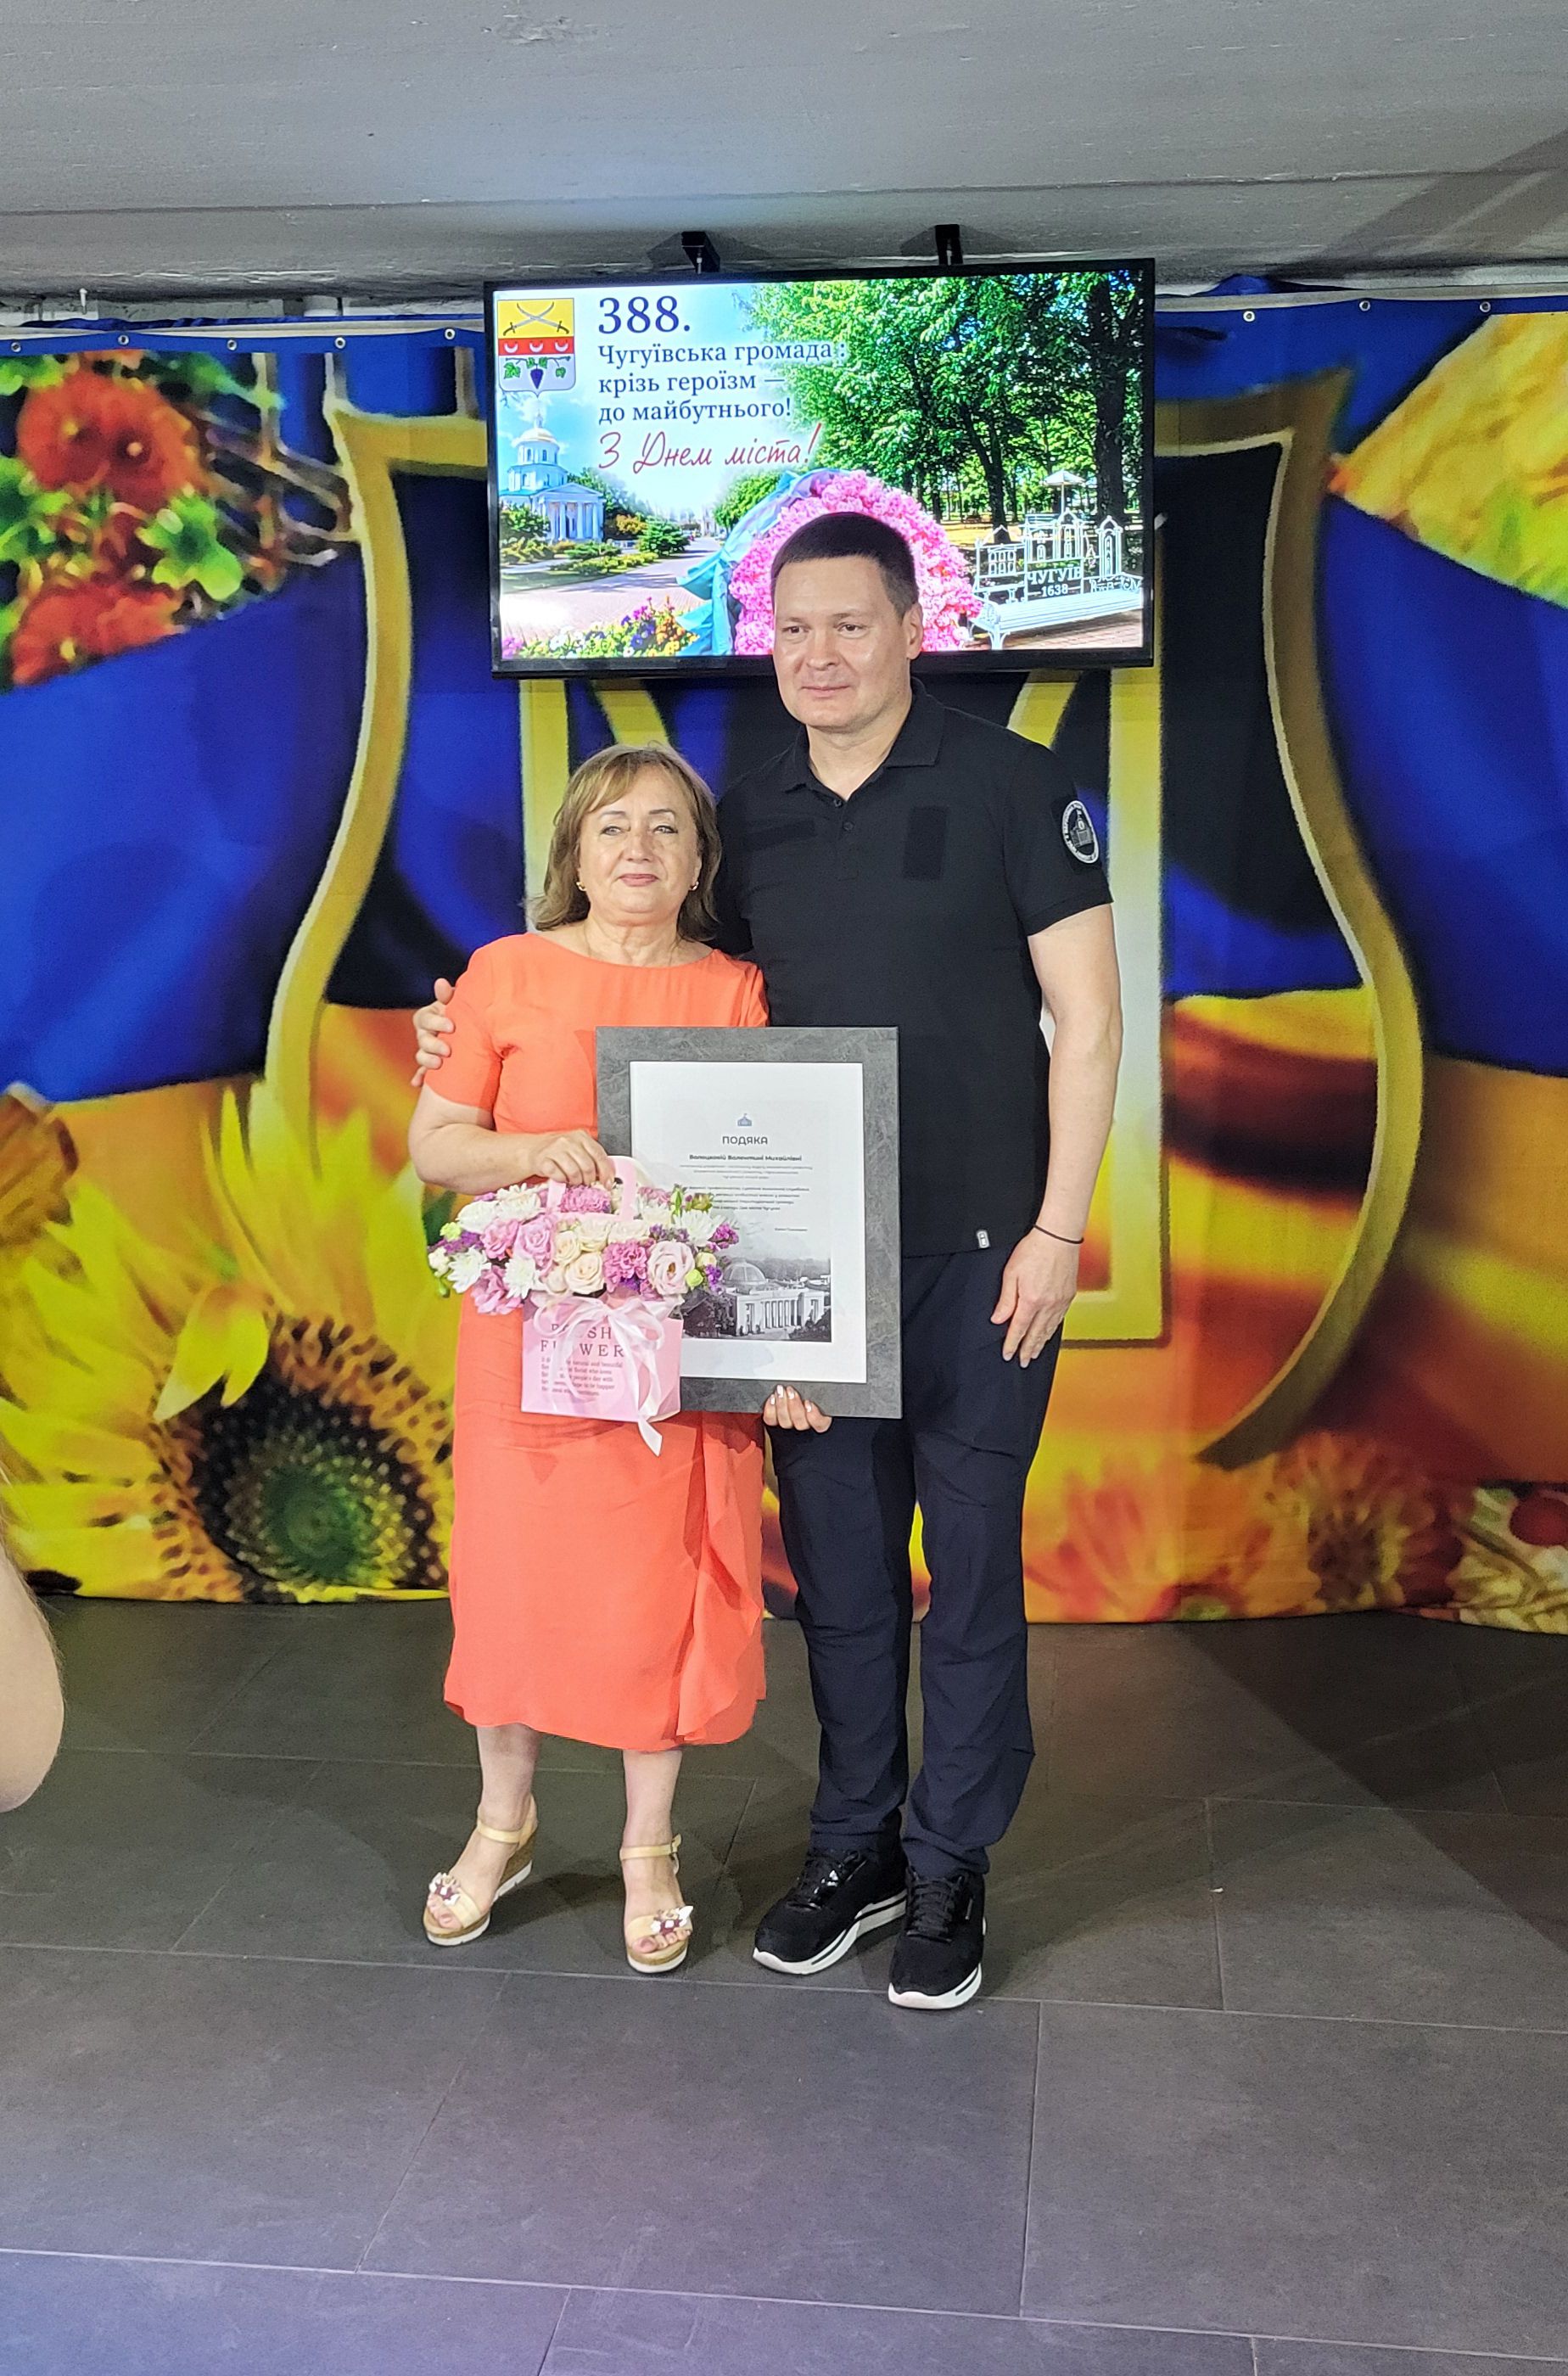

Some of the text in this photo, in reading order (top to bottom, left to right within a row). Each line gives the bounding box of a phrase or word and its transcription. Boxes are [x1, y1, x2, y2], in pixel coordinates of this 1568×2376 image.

[598, 295, 691, 334] 388.
[598, 343, 726, 369] Чугуївська
[598, 372, 660, 398] крізь
[667, 370, 756, 395] героїзм
[598, 397, 791, 425] до майбутнього!
[598, 423, 822, 474] З Днем міста!
[1040, 584, 1069, 597] 1638
[722, 1135, 768, 1146] ПОДЯКА
[540, 1339, 624, 1358] FWER
